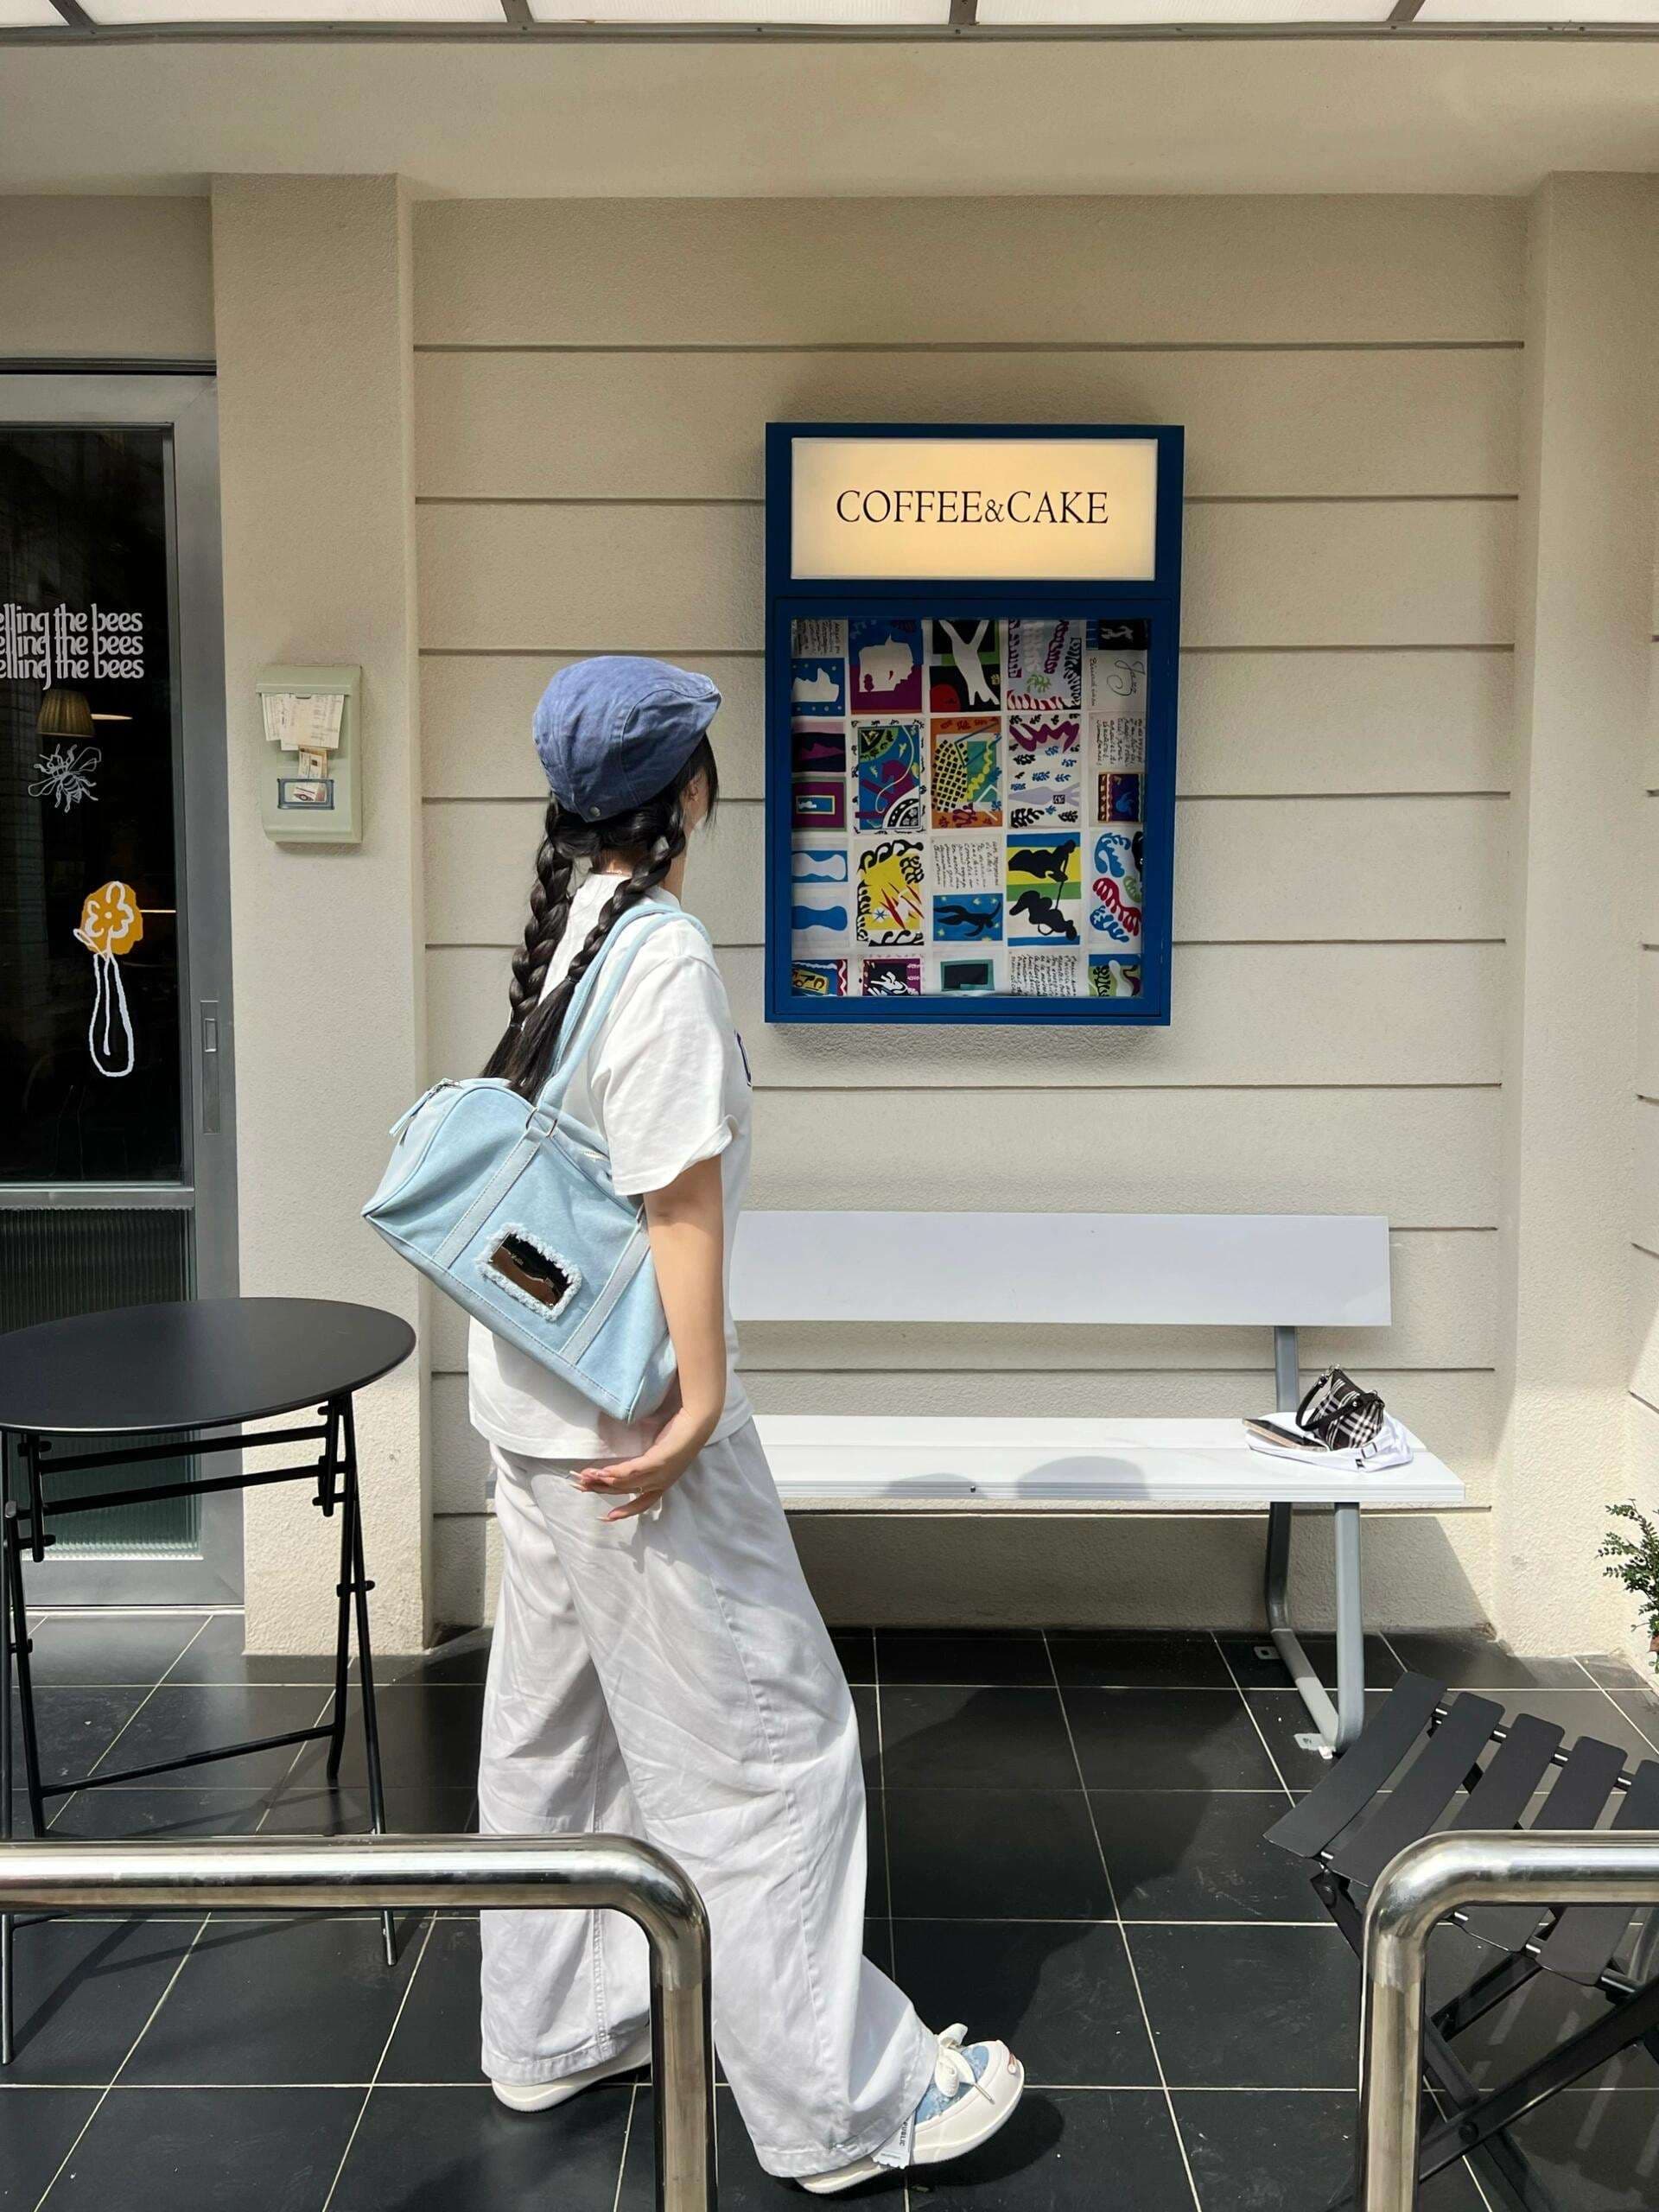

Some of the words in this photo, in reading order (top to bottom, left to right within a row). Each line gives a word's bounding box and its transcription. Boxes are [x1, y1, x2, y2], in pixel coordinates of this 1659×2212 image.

[836, 490, 1109, 524] COFFEE&CAKE
[54, 603, 87, 632] the
[91, 603, 143, 632] bees
[54, 635, 88, 656] the
[92, 635, 144, 656] bees
[55, 658, 89, 679] the
[94, 658, 145, 679] bees
